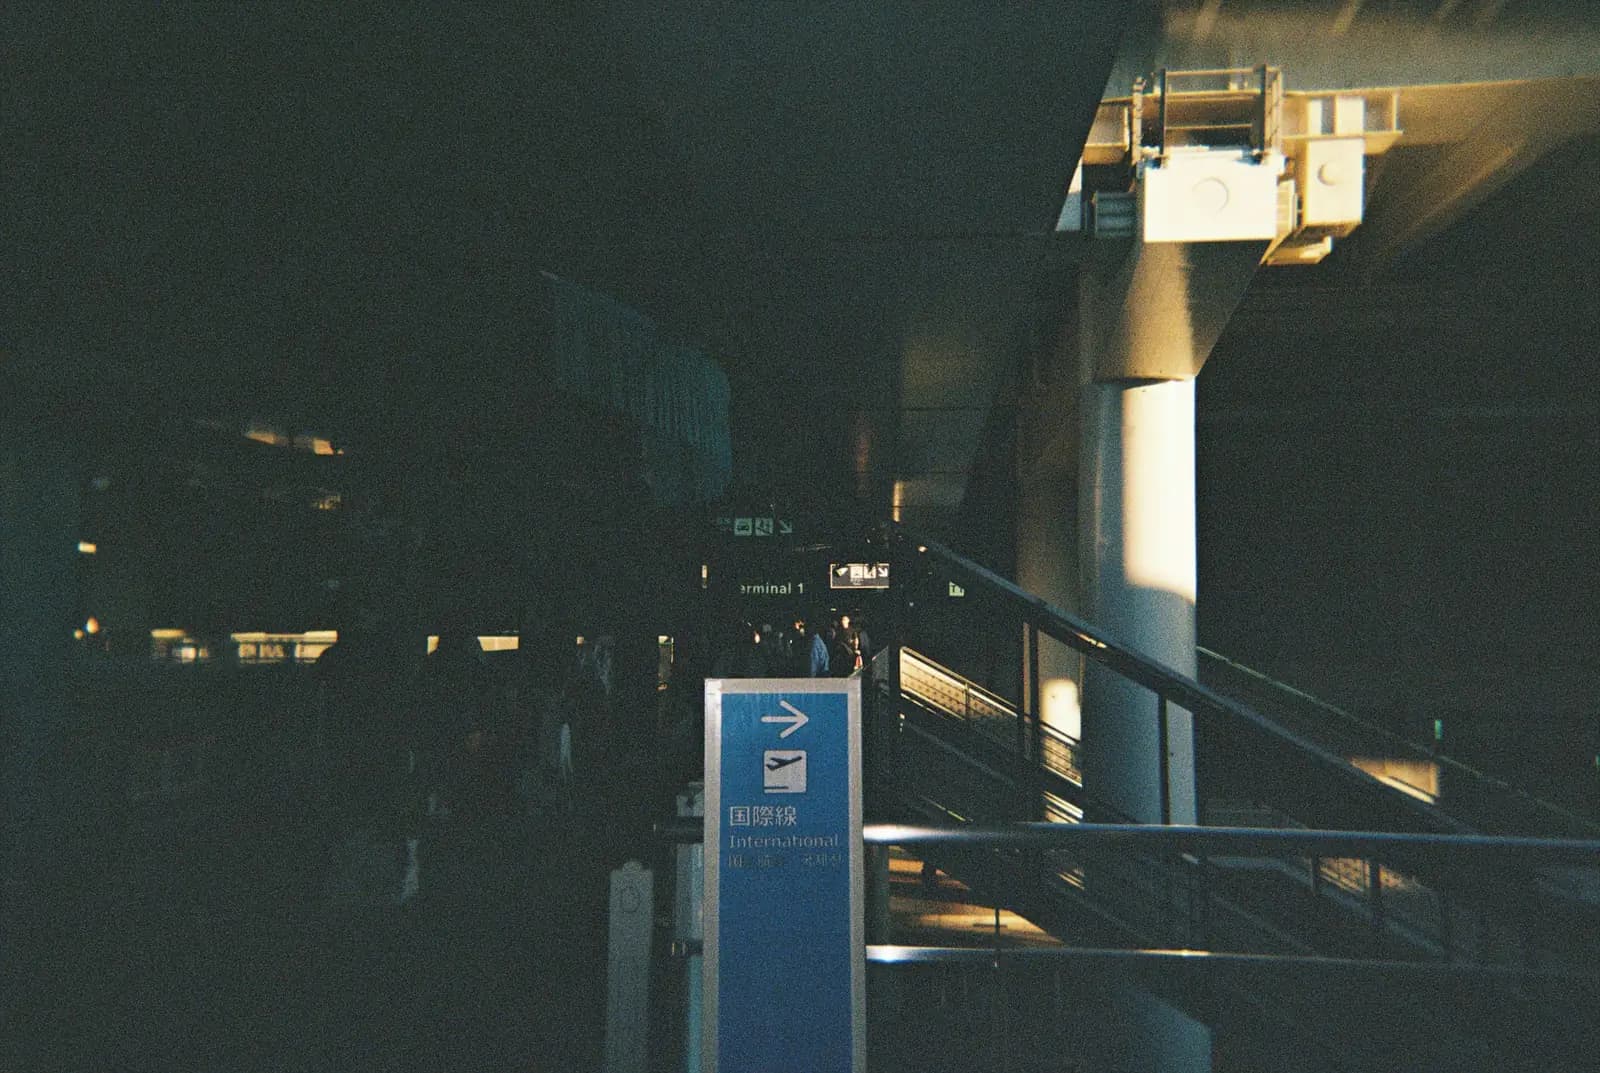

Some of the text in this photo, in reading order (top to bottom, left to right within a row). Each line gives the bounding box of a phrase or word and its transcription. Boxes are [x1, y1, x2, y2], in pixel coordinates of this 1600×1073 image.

[740, 582, 804, 594] erminal 1
[730, 806, 797, 826] 国際線
[729, 835, 838, 848] International
